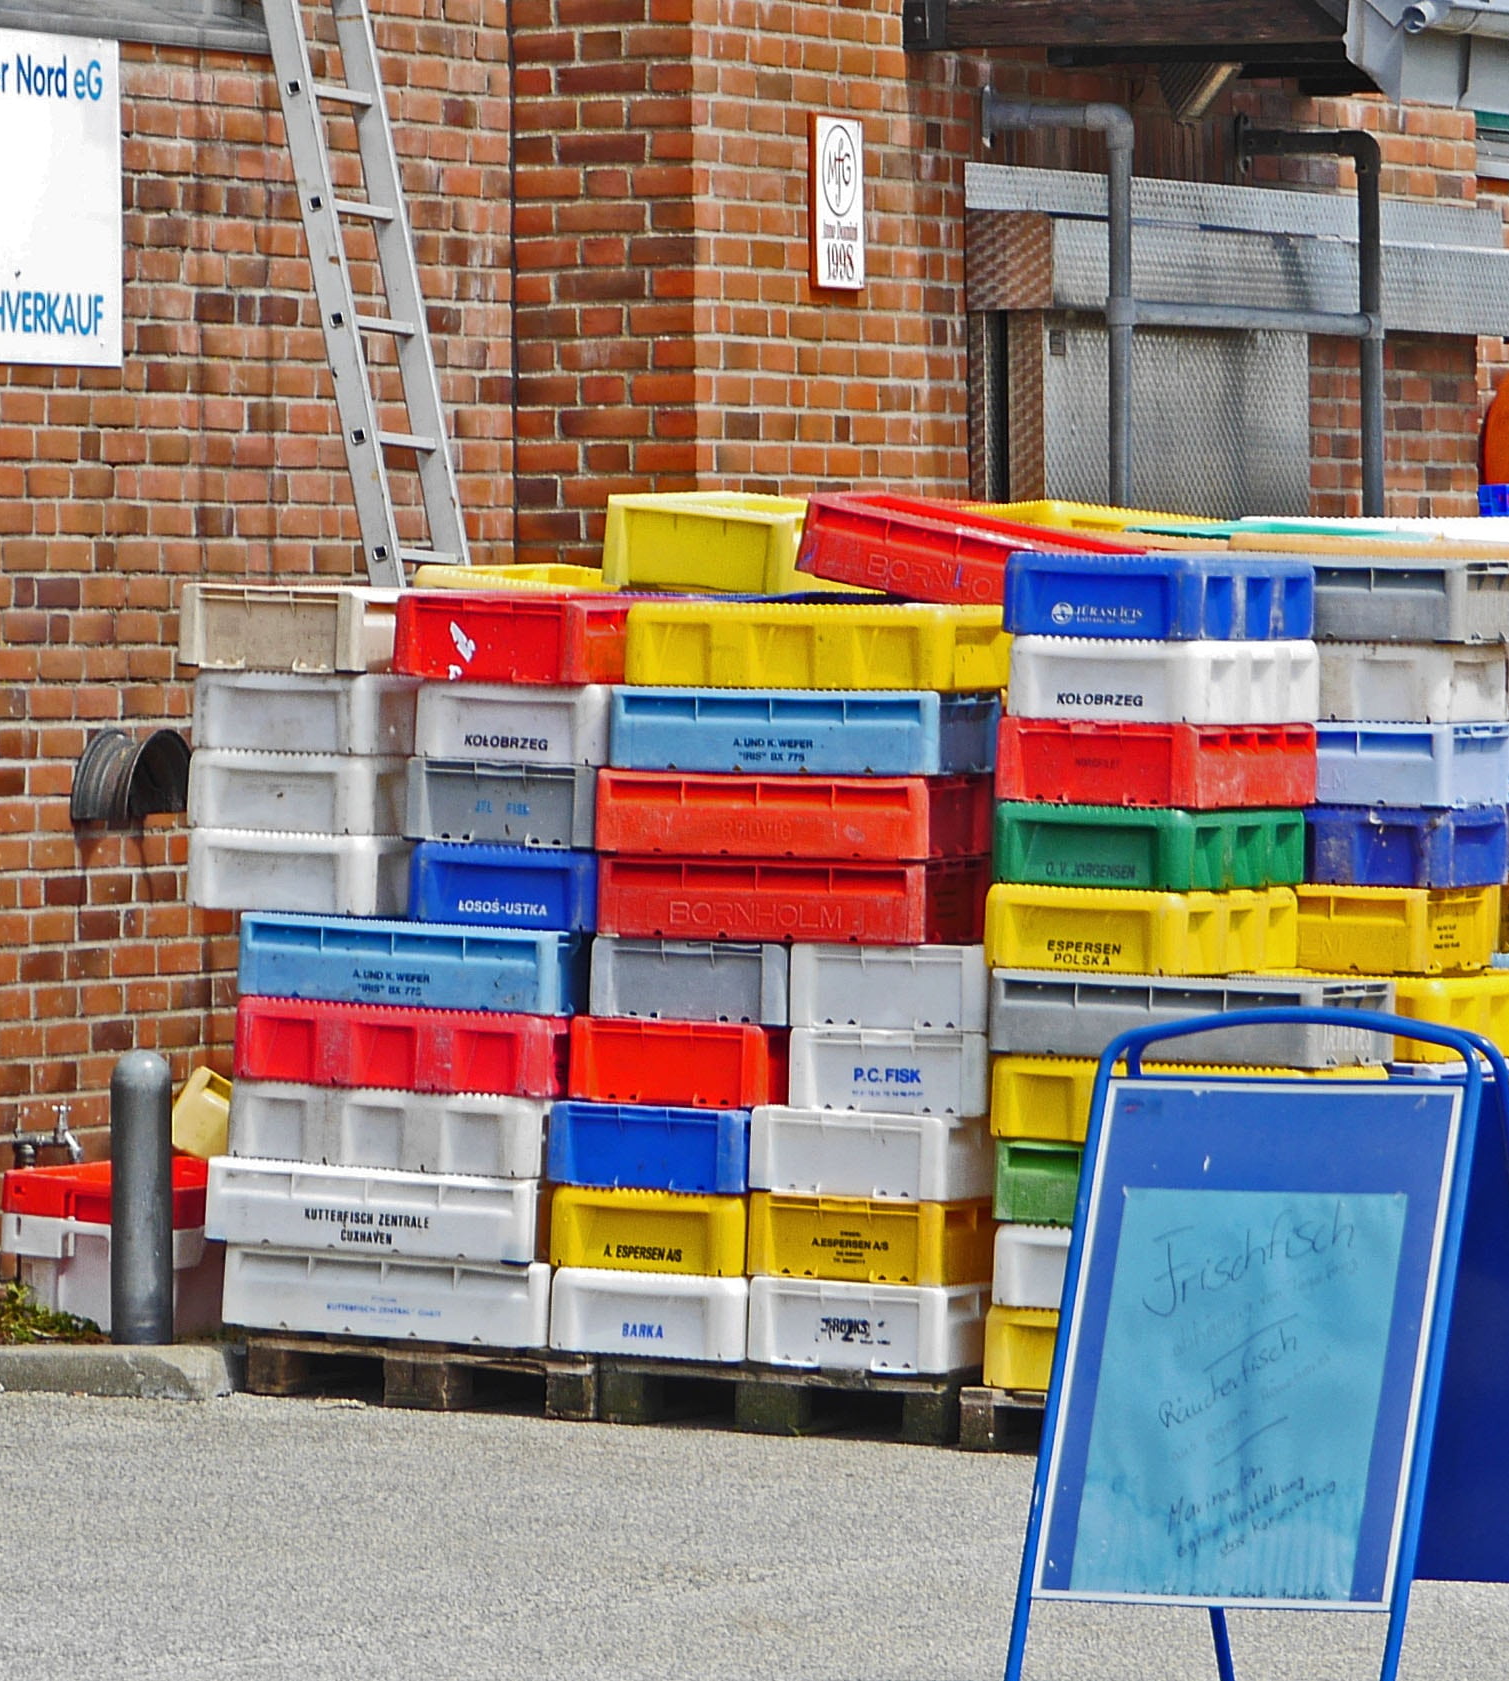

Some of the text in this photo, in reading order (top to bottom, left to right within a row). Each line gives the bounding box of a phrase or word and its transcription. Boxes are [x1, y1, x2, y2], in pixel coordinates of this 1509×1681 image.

[17, 54, 68, 99] Nord
[73, 60, 103, 101] eG
[827, 242, 855, 282] 1998
[1056, 692, 1144, 708] KOŁOBRZEG
[464, 733, 549, 752] KOŁOBRZEG
[669, 900, 842, 931] BORNHOLM
[1046, 939, 1122, 956] ESPERSEN
[1053, 953, 1110, 967] POLSKA
[853, 1067, 922, 1084] P.C. FISK
[304, 1207, 430, 1230] KUTTERFISCH ZENTRALE
[340, 1227, 393, 1246] CUXHAVEN
[616, 1244, 666, 1261] ESPERSEN
[666, 1247, 682, 1263] A/S
[621, 1322, 664, 1340] BARKA
